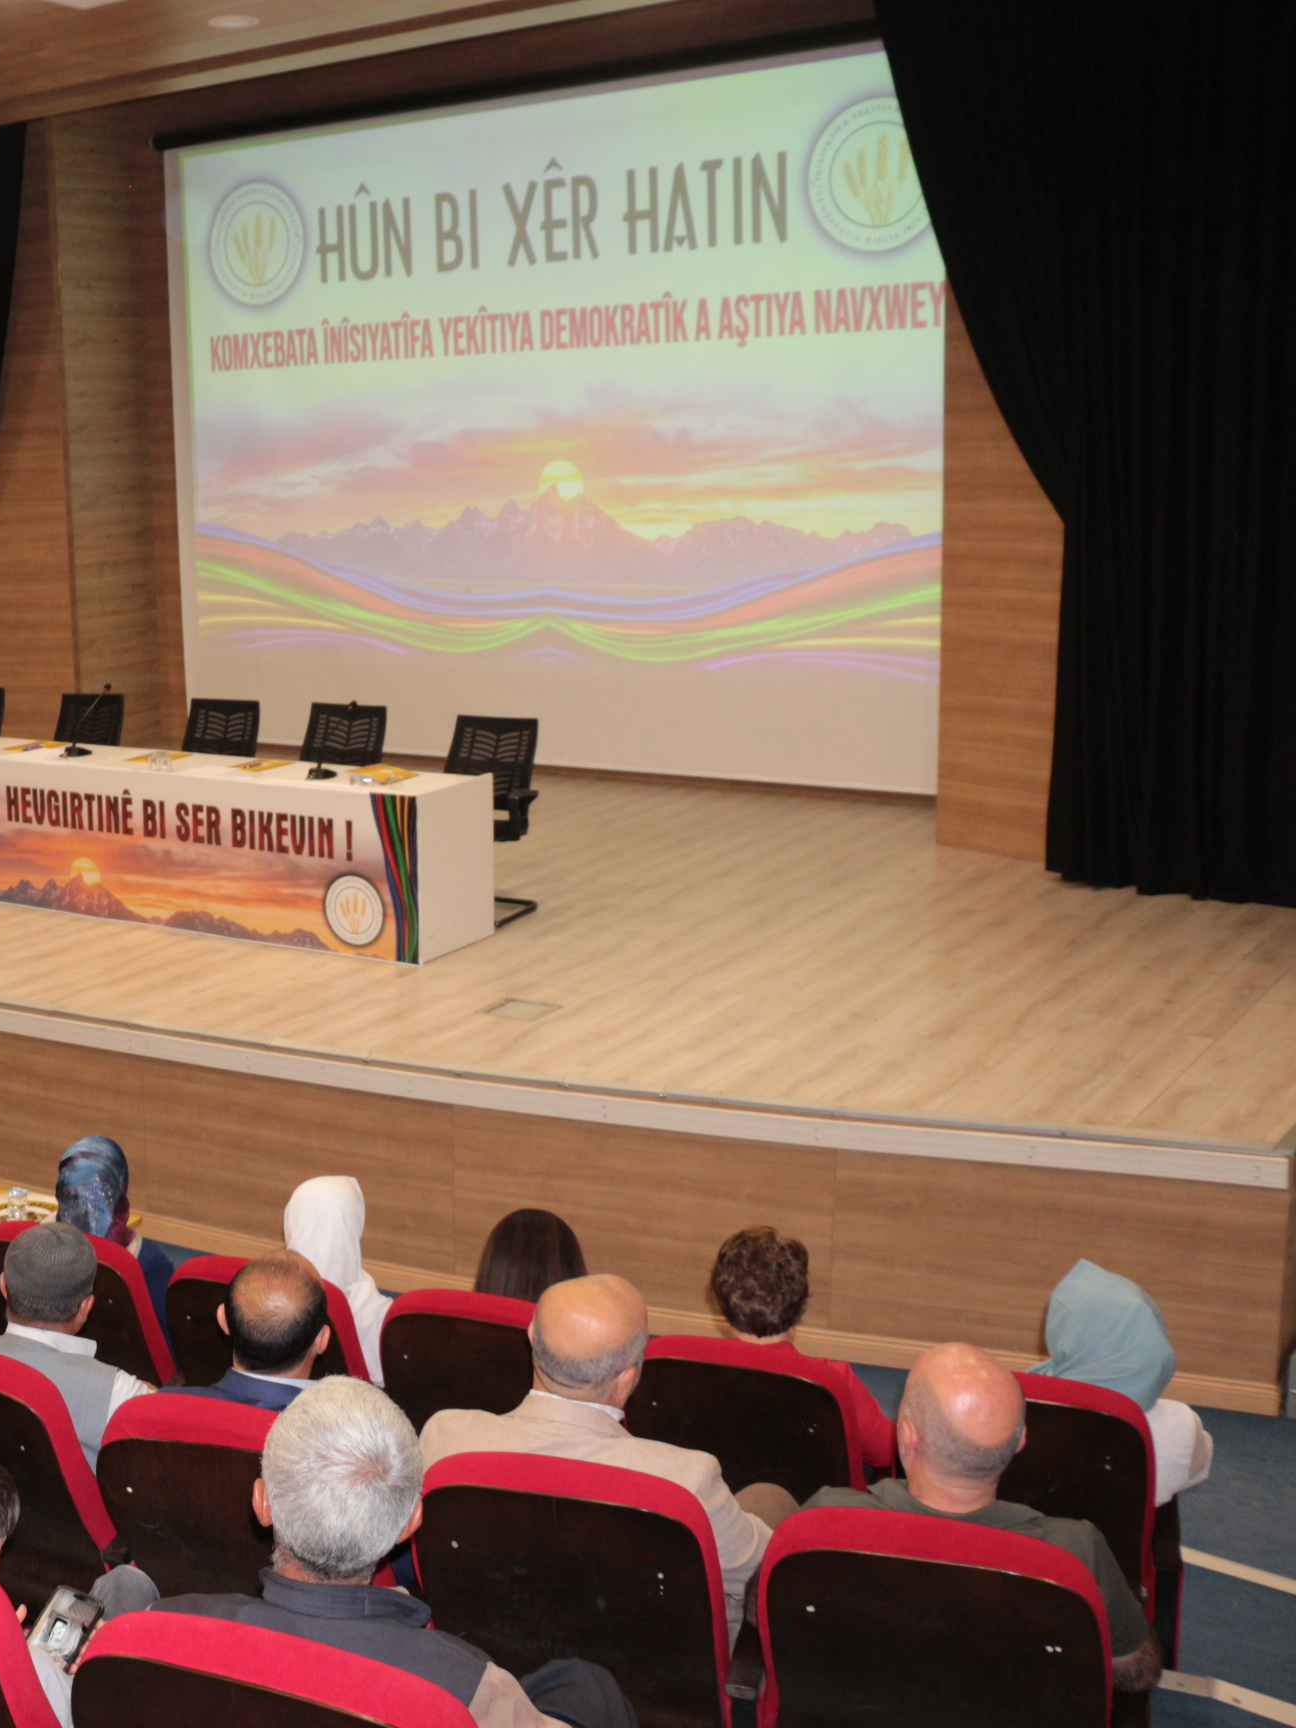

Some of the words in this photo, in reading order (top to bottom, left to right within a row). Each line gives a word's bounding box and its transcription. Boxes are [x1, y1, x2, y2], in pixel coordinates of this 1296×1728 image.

[316, 182, 412, 284] HÛN
[434, 188, 479, 273] BI
[502, 157, 600, 268] XÊR
[622, 151, 788, 254] HATIN
[210, 327, 319, 372] KOMXEBATA
[321, 311, 434, 364] ÎNÎSIYATÎFA
[439, 305, 534, 356] YEKÎTIYA
[540, 291, 688, 350] DEMOKRATÎK
[695, 298, 712, 341] A
[718, 290, 806, 347] AŞTIYA
[814, 280, 946, 334] NAVXWEY
[5, 785, 134, 836] HEVGIRTINÊ
[142, 799, 166, 839] BI
[175, 802, 221, 846] SER
[231, 808, 334, 859] BIKEVIN
[345, 820, 353, 862] !
